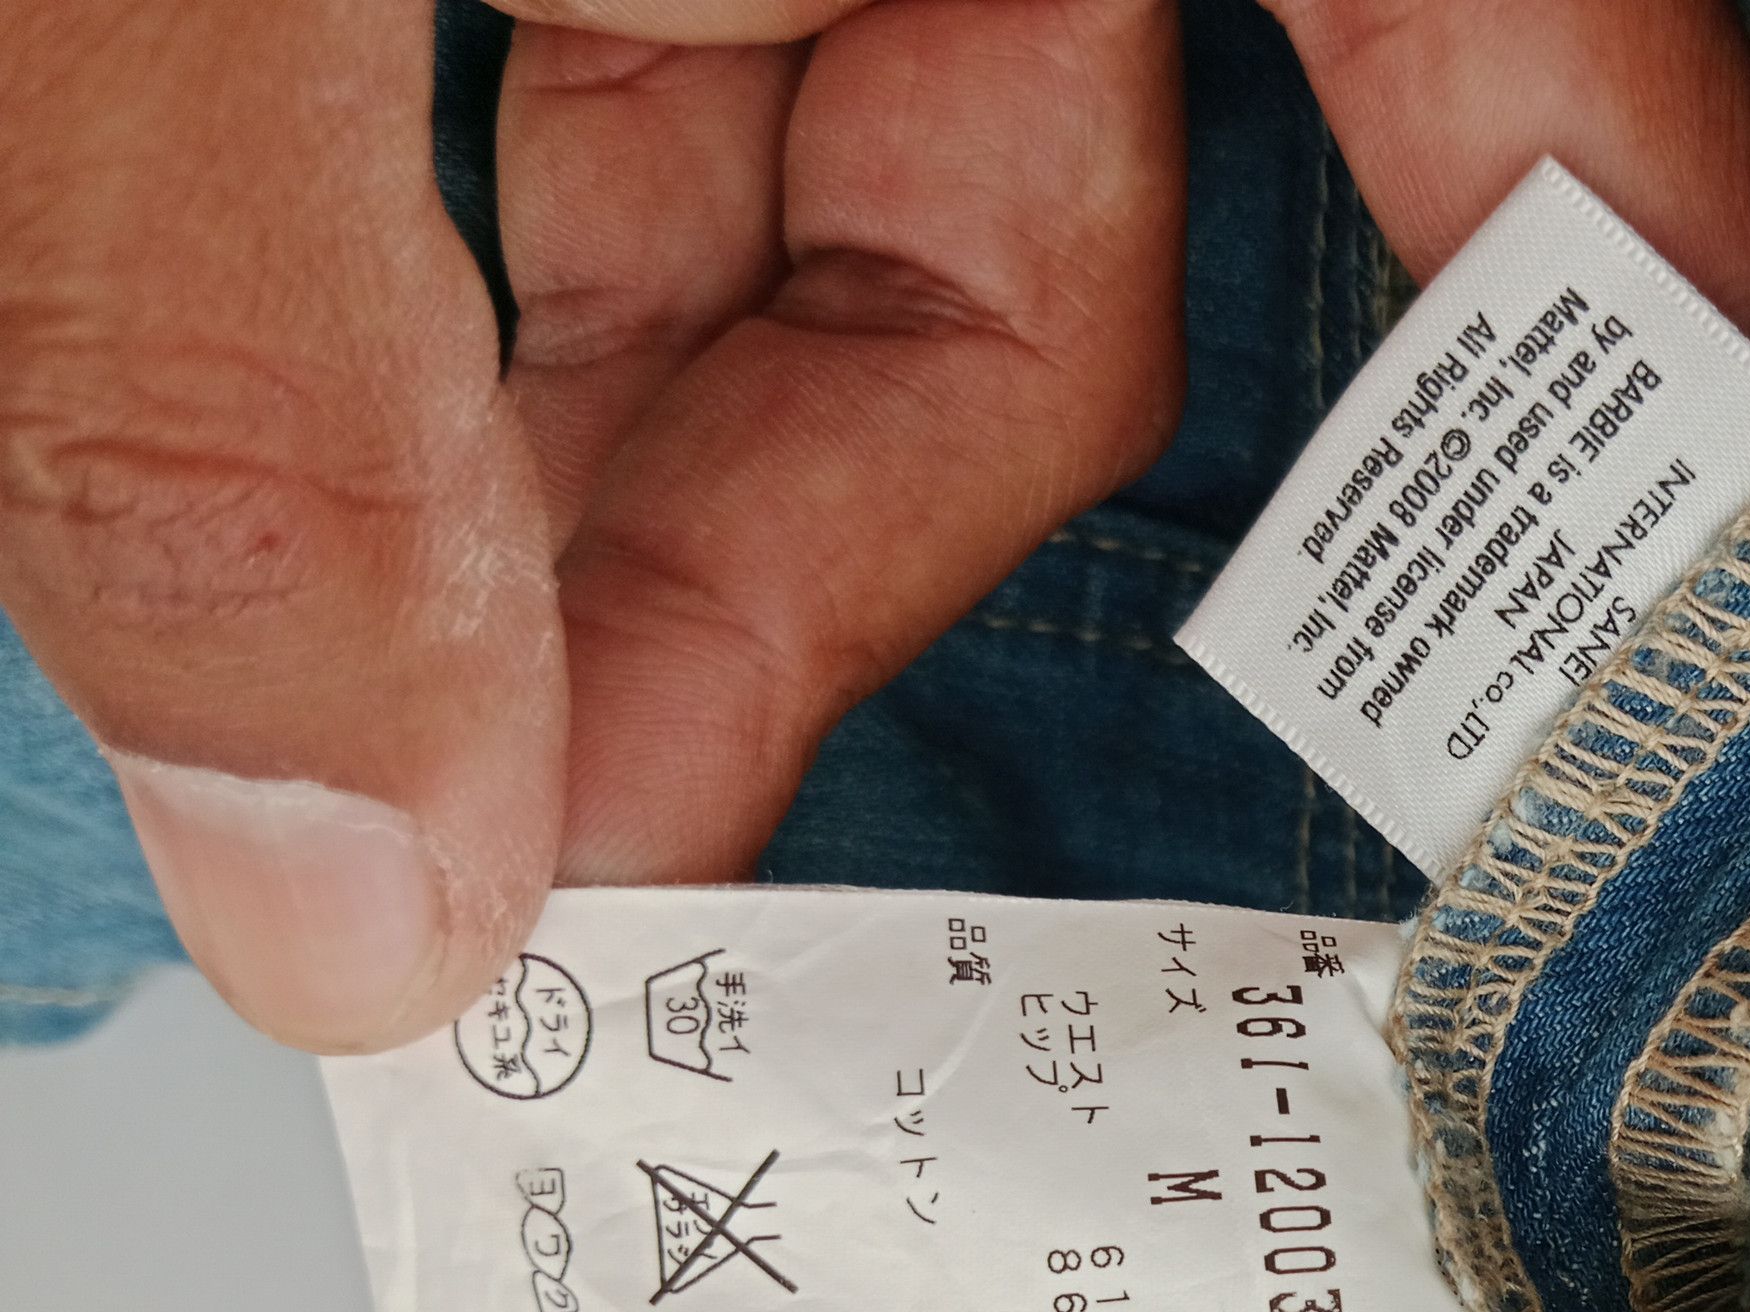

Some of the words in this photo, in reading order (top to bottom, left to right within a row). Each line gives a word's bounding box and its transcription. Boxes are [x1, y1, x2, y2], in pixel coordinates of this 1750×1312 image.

[1455, 310, 1497, 360] All
[1498, 286, 1591, 378] Mattel,
[1590, 314, 1634, 356] by
[1390, 351, 1470, 439] Rights
[1460, 375, 1515, 423] Inc.
[1546, 350, 1597, 411] and
[1567, 358, 1663, 464] BARBIE
[1388, 427, 1472, 529] ©2008
[1493, 401, 1555, 476] used
[1546, 452, 1582, 485] is
[1434, 467, 1501, 551] under
[1526, 480, 1553, 506] a
[1316, 521, 1401, 614] Mattel,
[1364, 544, 1447, 639] license
[1423, 504, 1540, 640] trademark
[1493, 528, 1577, 631] JAPAN
[1508, 457, 1697, 676] INTERNATIONAL
[1287, 607, 1337, 654] Inc.
[1316, 635, 1376, 701] from
[1562, 595, 1638, 690] SANEI
[1359, 635, 1432, 730] owned
[948, 918, 991, 986] 品質
[1158, 923, 1206, 1014] サイズ
[1300, 930, 1344, 978] 品番
[534, 987, 572, 1058] ドライ
[666, 996, 699, 1035] 30
[1020, 993, 1069, 1093] ヒップ
[1062, 990, 1109, 1124] ウエスト
[894, 1068, 939, 1225] コットン
[1148, 1169, 1222, 1205] M
